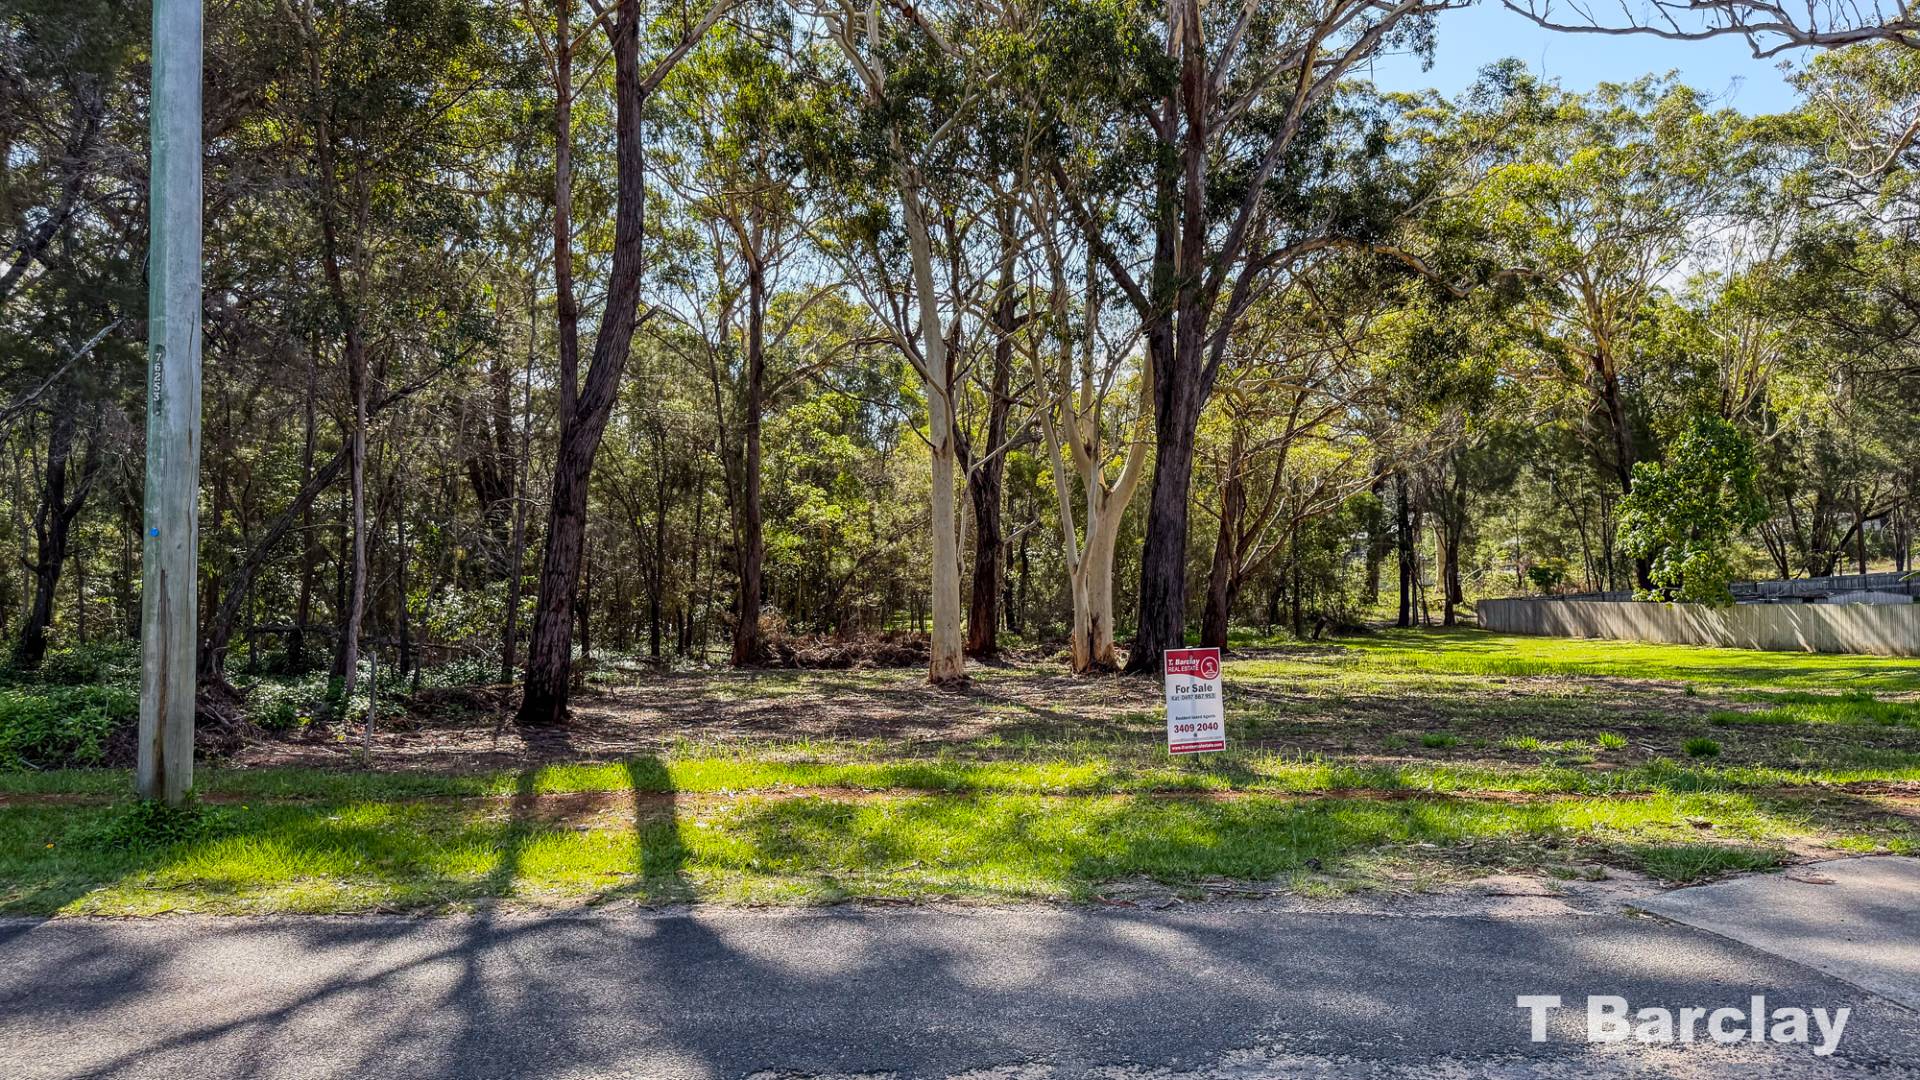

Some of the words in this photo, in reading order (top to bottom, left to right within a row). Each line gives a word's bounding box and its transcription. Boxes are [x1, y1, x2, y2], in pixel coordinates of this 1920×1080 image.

[1175, 657, 1201, 667] Barclay
[1175, 684, 1190, 694] For
[1191, 683, 1213, 693] Sale
[1173, 723, 1195, 734] 3409
[1196, 722, 1219, 732] 2040
